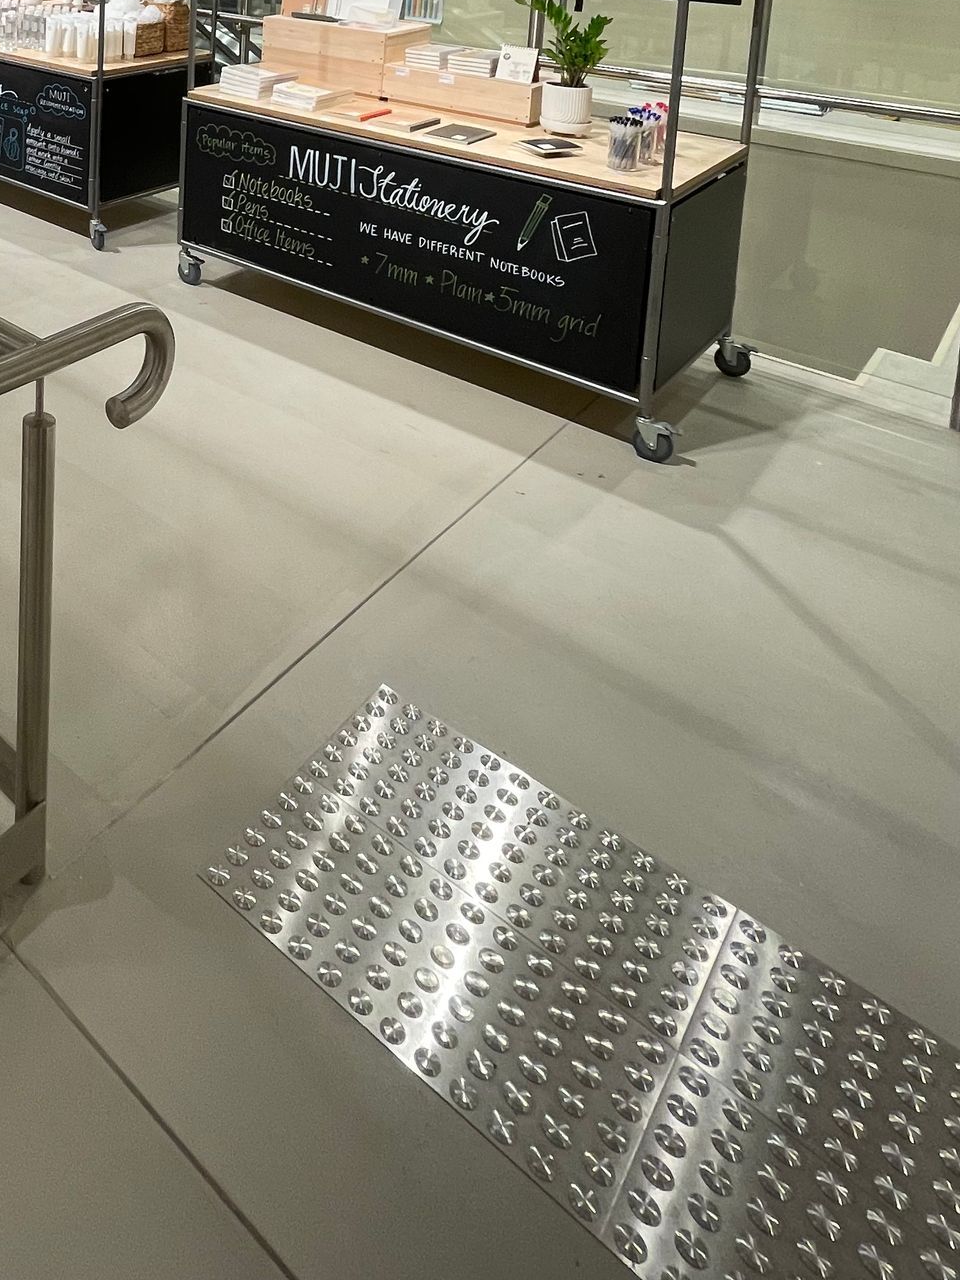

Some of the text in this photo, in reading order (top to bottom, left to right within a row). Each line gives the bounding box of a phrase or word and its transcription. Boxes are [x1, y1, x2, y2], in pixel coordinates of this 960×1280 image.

[48, 89, 70, 103] MUJI
[13, 105, 29, 115] SOAP
[26, 123, 45, 140] Apply
[53, 135, 71, 145] small
[202, 133, 271, 159] Popular items
[61, 145, 79, 157] hands
[238, 172, 313, 208] Notebooks
[289, 145, 500, 246] MUJI Stationery
[236, 194, 269, 218] Pens
[235, 215, 315, 256] Office Items
[359, 221, 566, 287] WE HAVE DIFFERENT NOTEBOOKS
[375, 251, 602, 342] 7mm Plain 5mm grid
